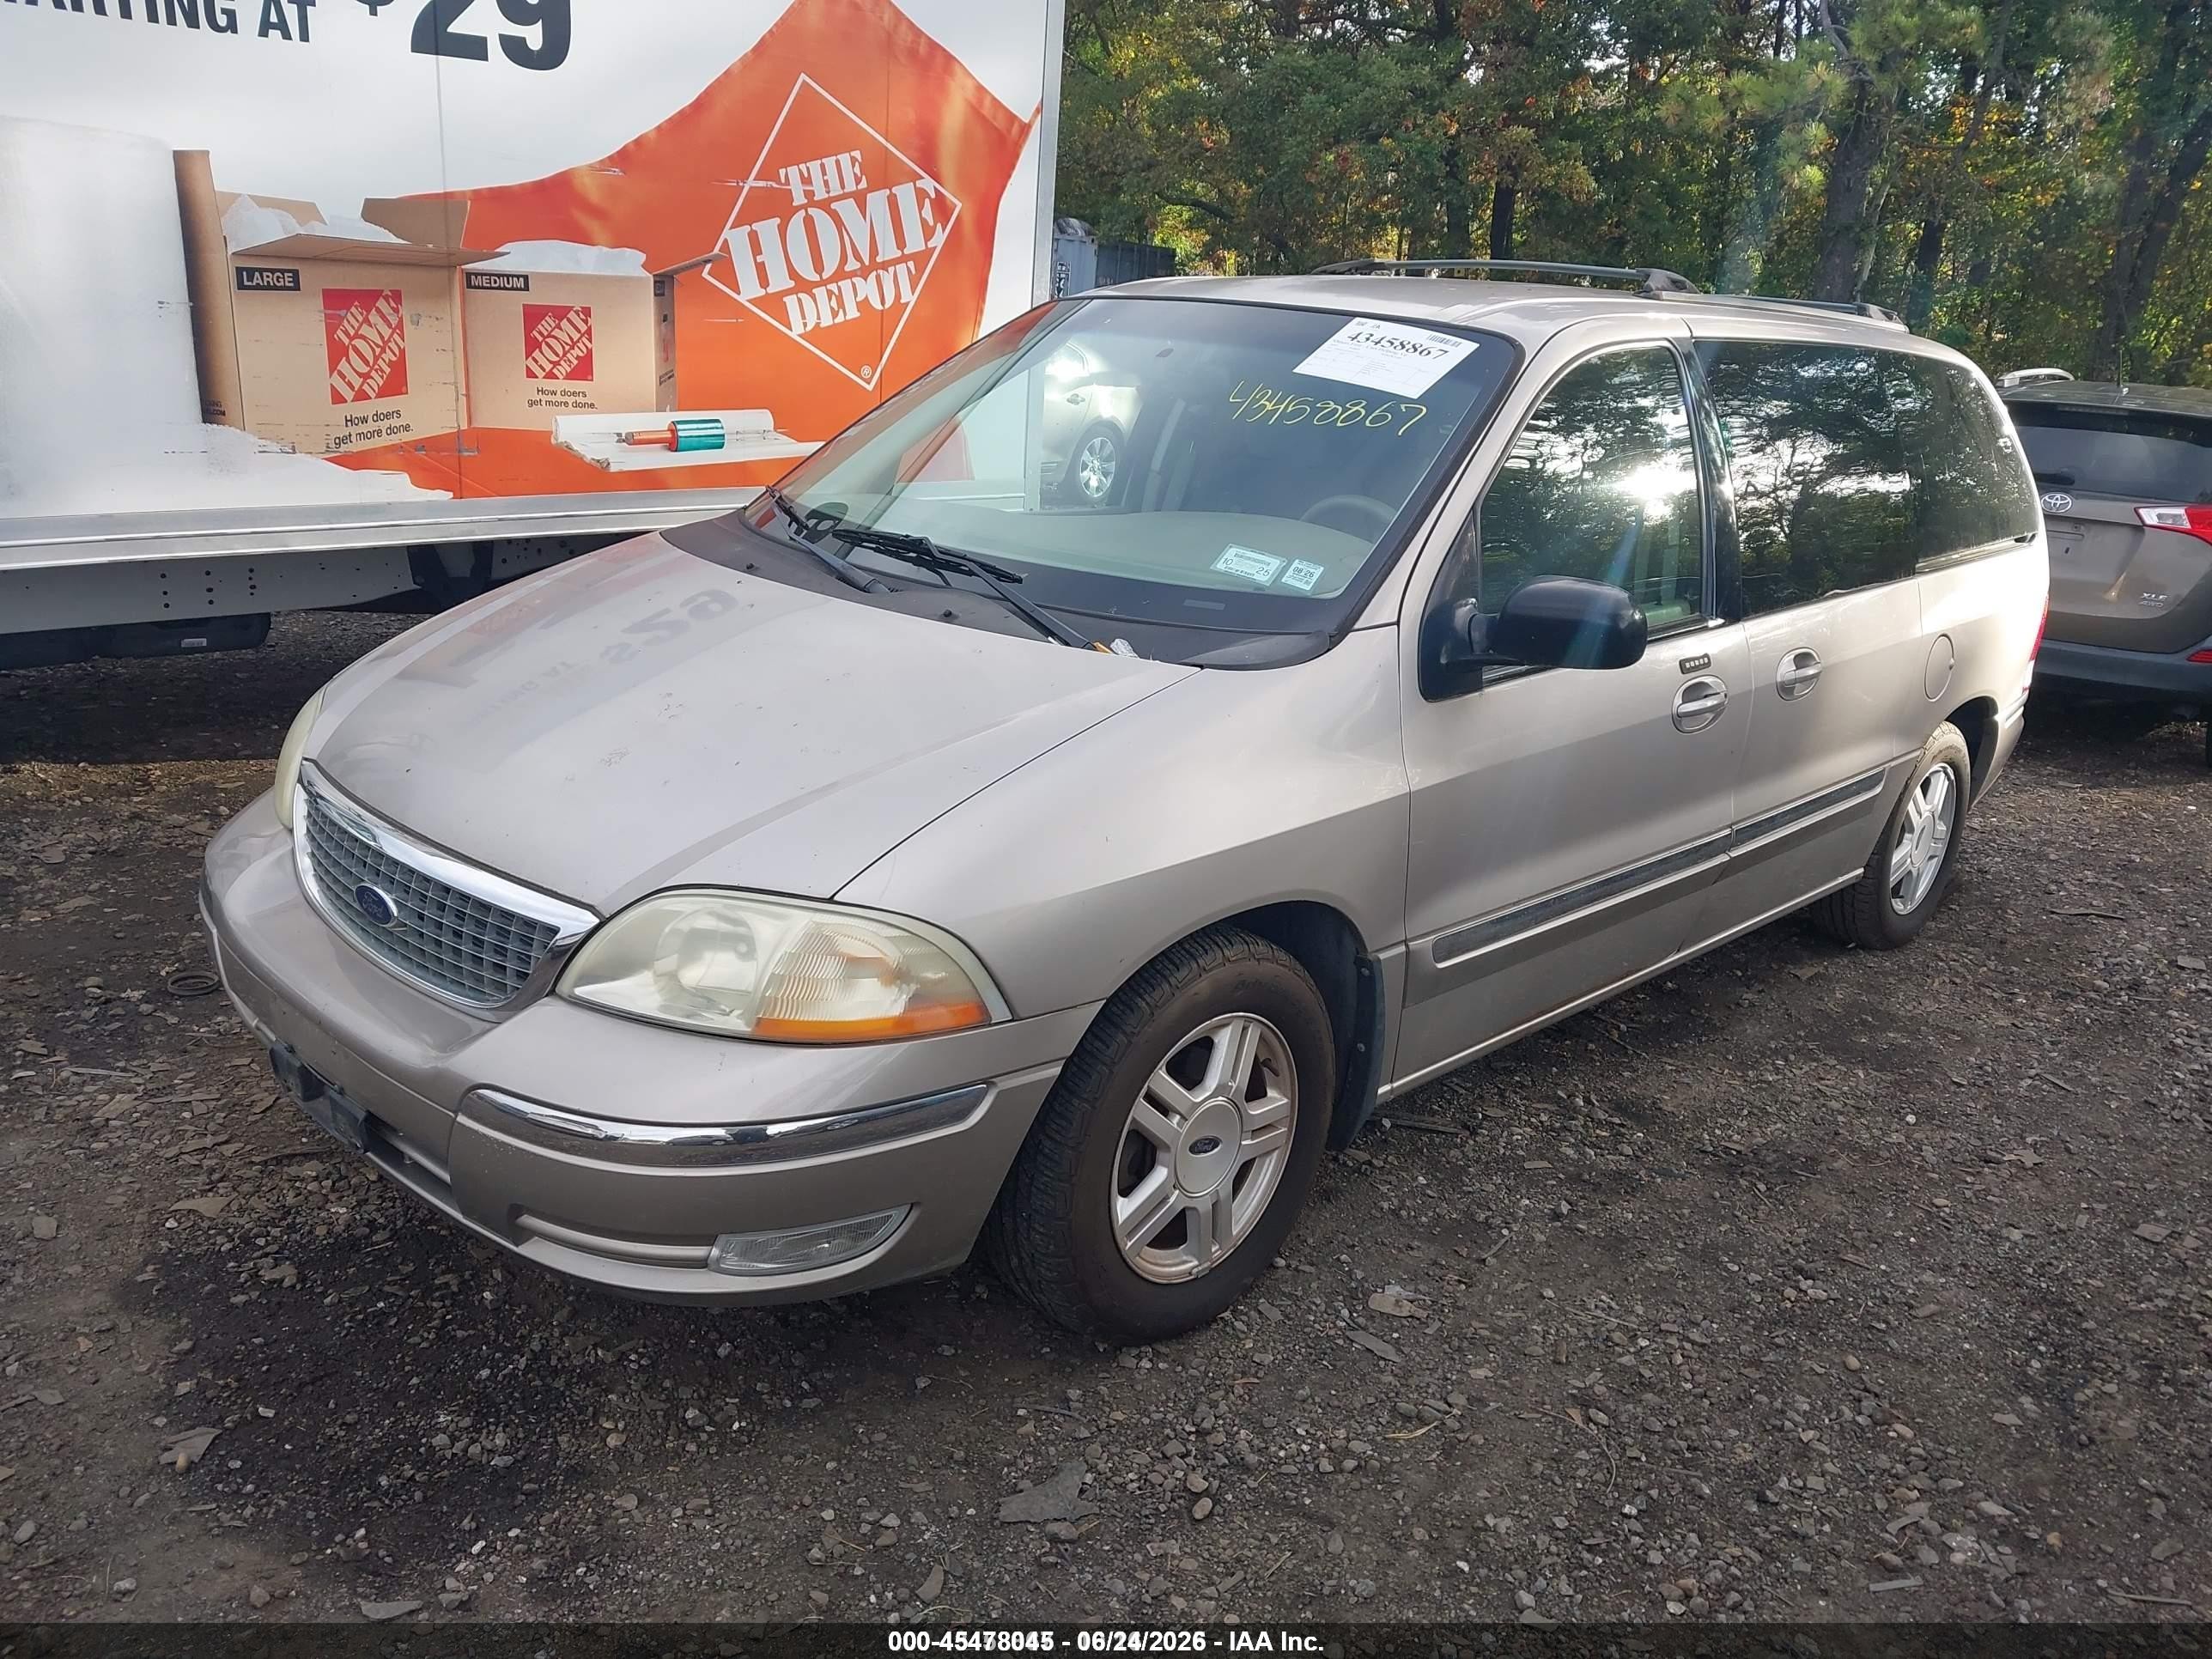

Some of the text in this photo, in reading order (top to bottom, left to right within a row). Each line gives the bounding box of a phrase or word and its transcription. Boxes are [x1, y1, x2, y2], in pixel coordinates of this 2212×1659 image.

[258, 0, 317, 42] AT
[779, 150, 867, 206] THE
[726, 177, 944, 300] HOME
[242, 271, 294, 287] LARGE
[471, 275, 525, 289] MEDIUM
[782, 260, 915, 335] DEPOT
[334, 301, 368, 346] THE
[526, 307, 591, 379] HOME
[530, 313, 559, 343] THE
[330, 290, 402, 402] HOME
[362, 329, 405, 399] DEPOT
[552, 333, 592, 380] DEPOT
[1346, 331, 1449, 360] 43458867
[527, 398, 599, 410] get more done.
[537, 386, 587, 398] How doers
[1229, 380, 1427, 435] 43458867
[333, 423, 414, 449] get more done.
[344, 409, 402, 428] How doers
[1255, 567, 1272, 577] 25
